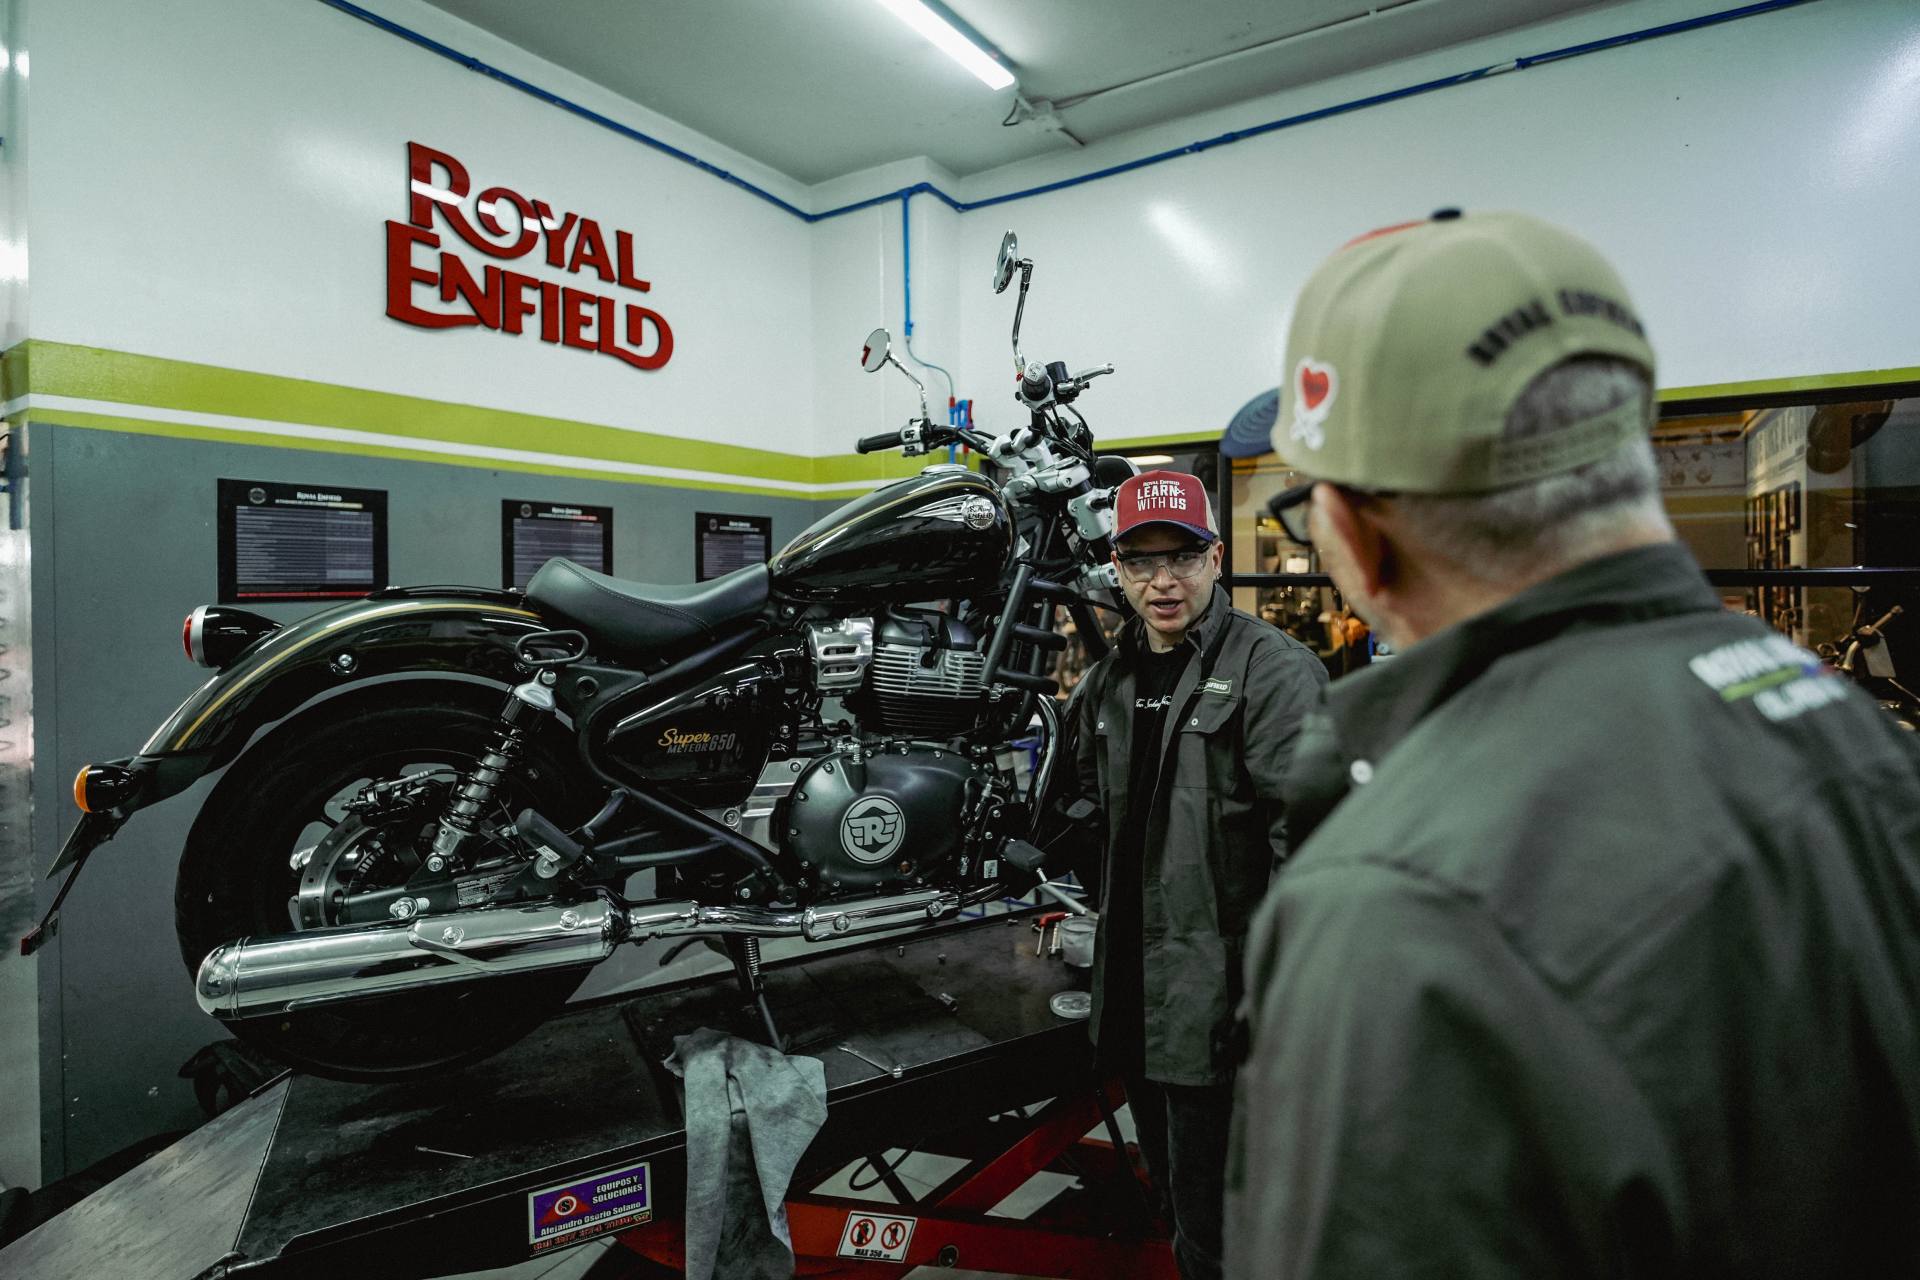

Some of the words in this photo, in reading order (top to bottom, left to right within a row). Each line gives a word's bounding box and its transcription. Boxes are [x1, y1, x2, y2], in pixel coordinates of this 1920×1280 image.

[406, 140, 651, 293] ROYAL
[385, 219, 674, 371] ENFIELD
[1137, 484, 1180, 500] LEARN
[1137, 496, 1166, 512] WITH
[1169, 496, 1187, 511] US
[658, 728, 711, 748] Super
[666, 742, 709, 754] METEOR
[708, 733, 736, 752] 650
[592, 1183, 643, 1204] SOLUCIONES
[596, 1177, 632, 1193] EQUIPOS
[632, 1175, 639, 1184] Y
[540, 1218, 583, 1236] Alejandro
